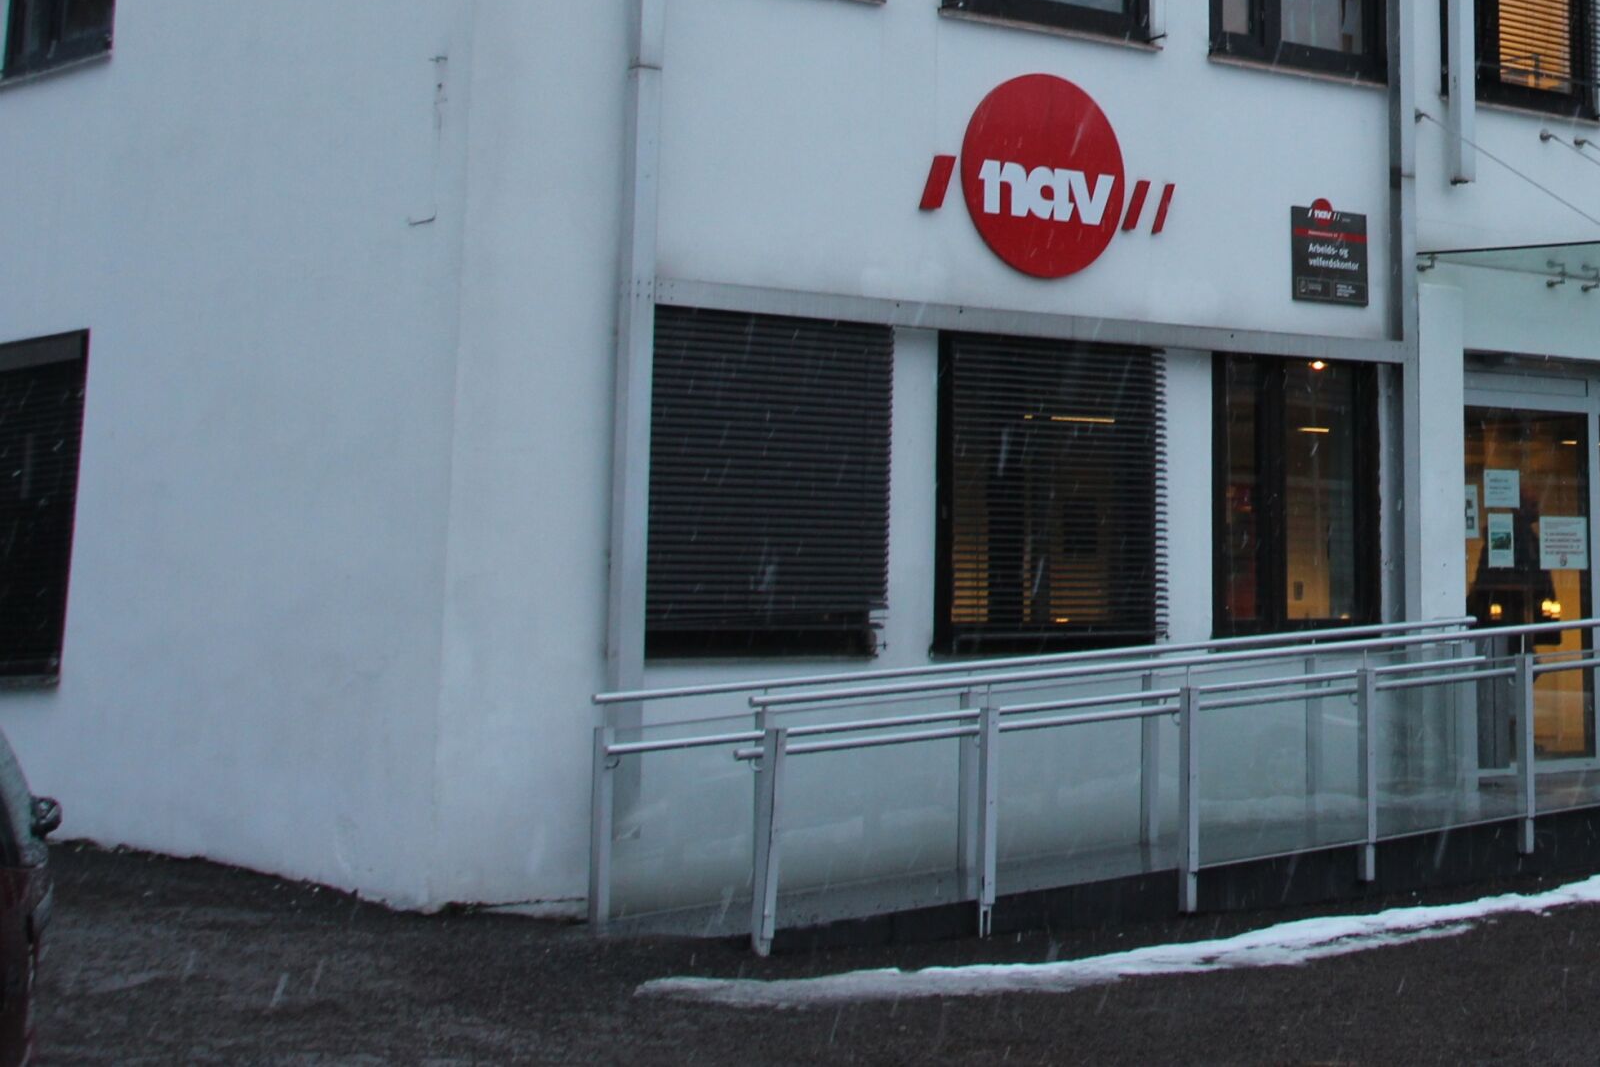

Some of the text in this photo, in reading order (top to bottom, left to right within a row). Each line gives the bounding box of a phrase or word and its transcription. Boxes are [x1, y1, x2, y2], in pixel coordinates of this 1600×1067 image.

[979, 159, 1115, 226] nav
[1308, 243, 1349, 258] Arbeids- og
[1308, 257, 1359, 271] velferdskontor
